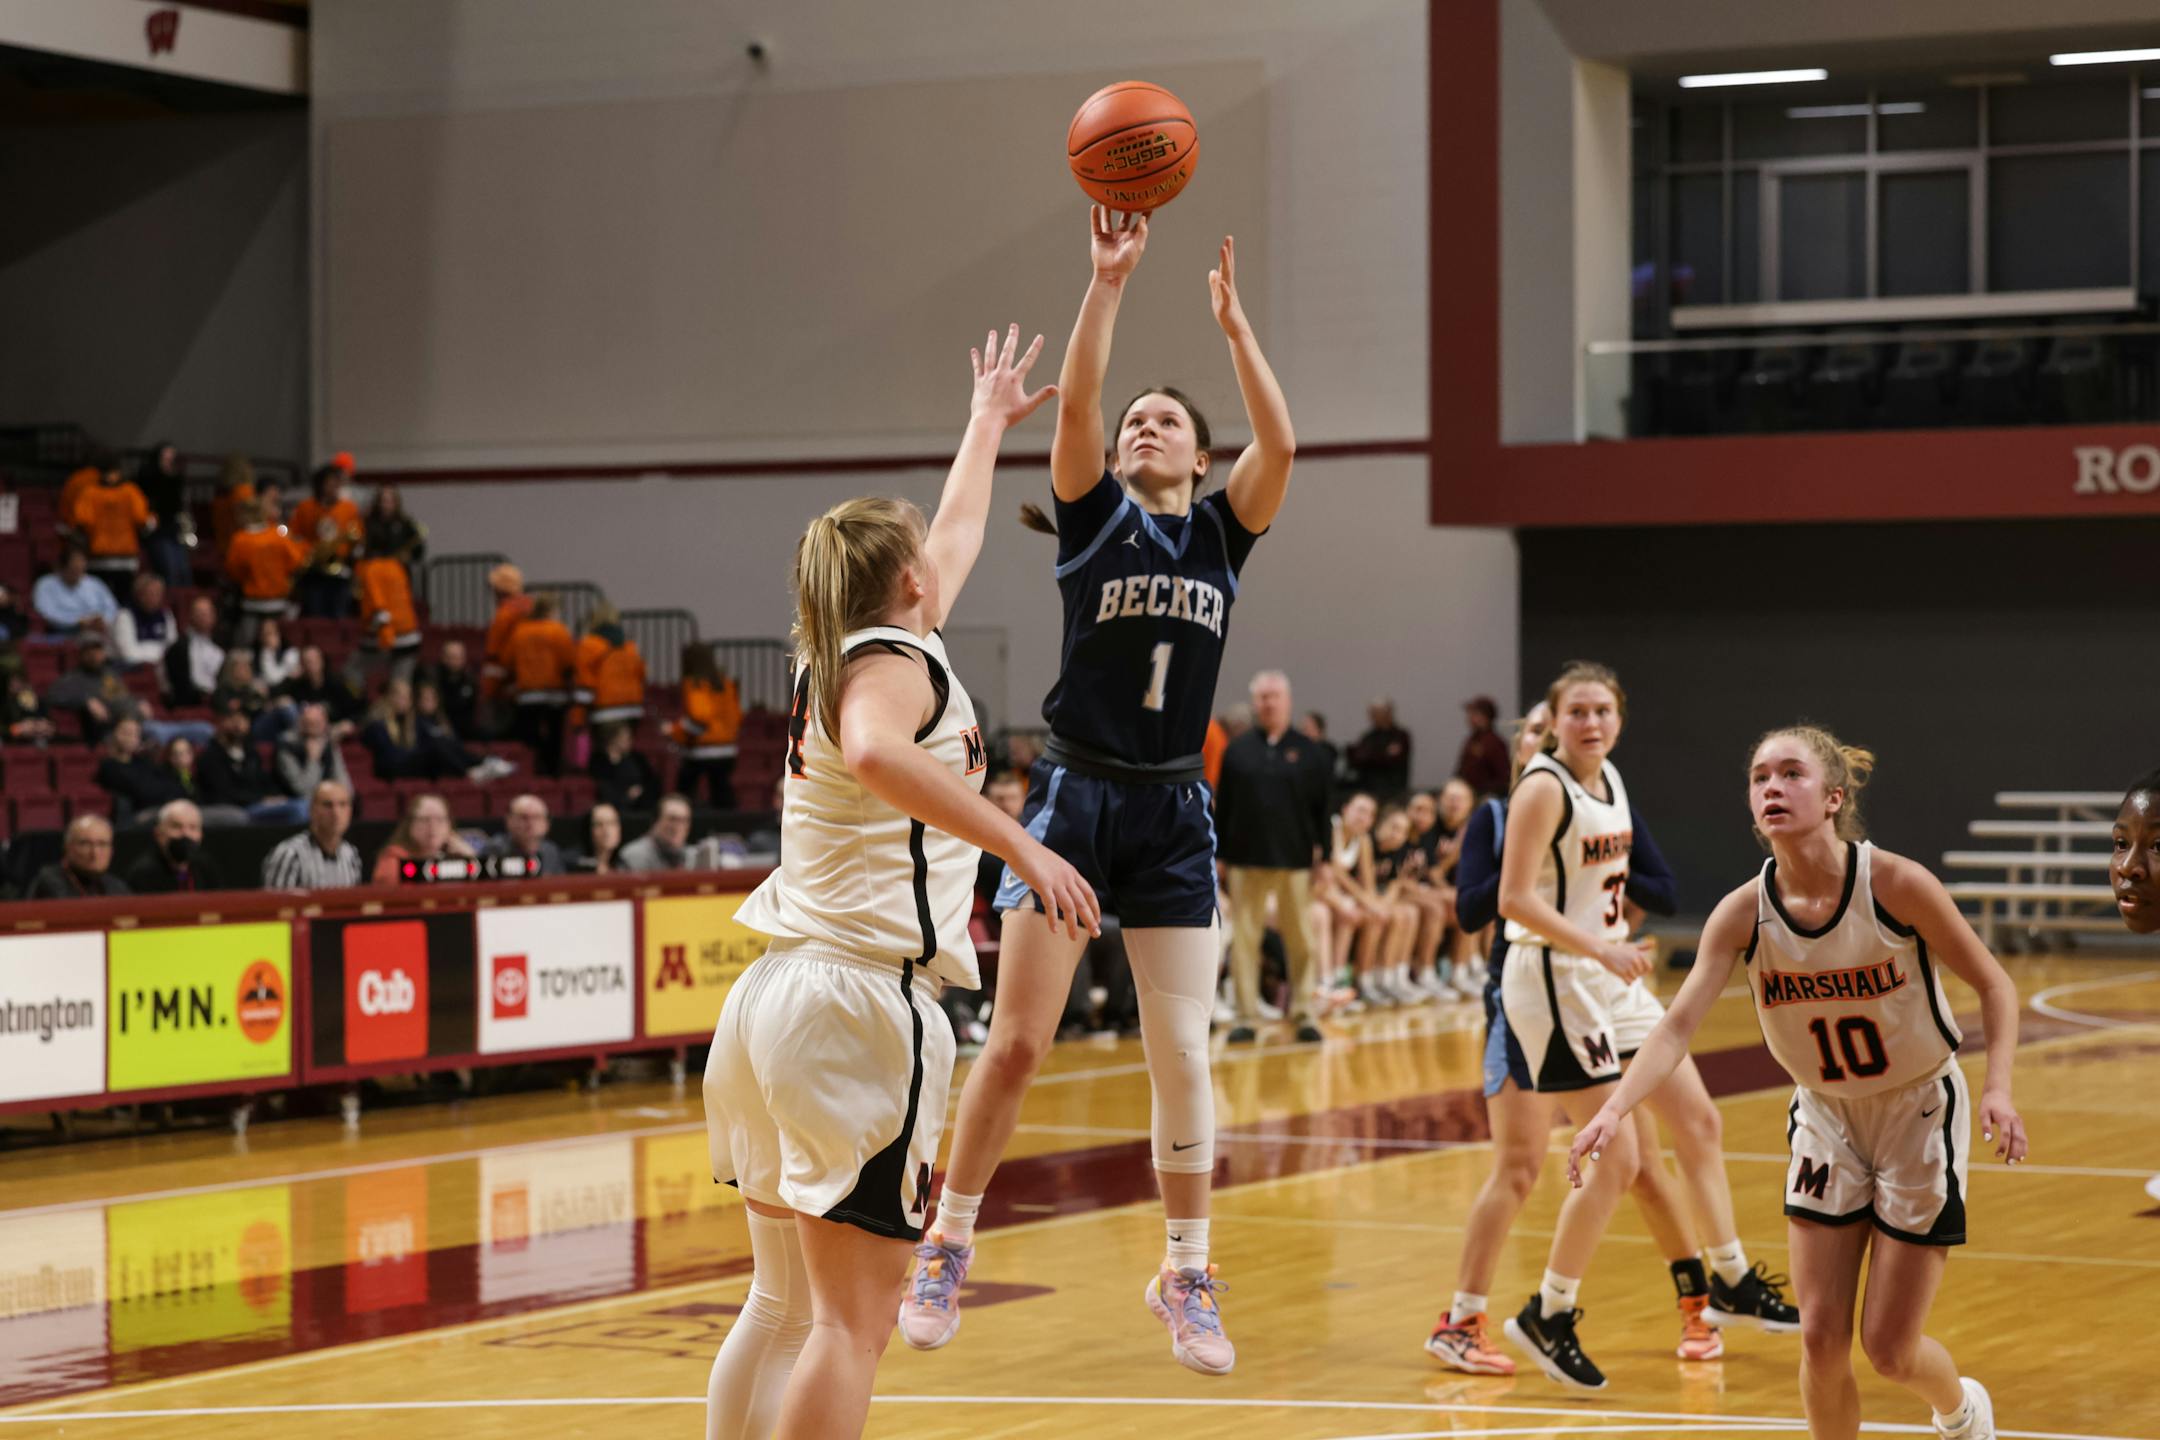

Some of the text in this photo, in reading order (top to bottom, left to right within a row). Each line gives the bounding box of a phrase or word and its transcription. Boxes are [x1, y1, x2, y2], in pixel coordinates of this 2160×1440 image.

[1096, 574, 1224, 639] BECKER
[1141, 641, 1174, 712] 1
[357, 968, 416, 1016] Cub
[536, 964, 625, 999] TOYOTA
[1760, 956, 1907, 1009] MARSHALL
[1808, 1015, 1890, 1083] 10
[1792, 1155, 1829, 1200] M
